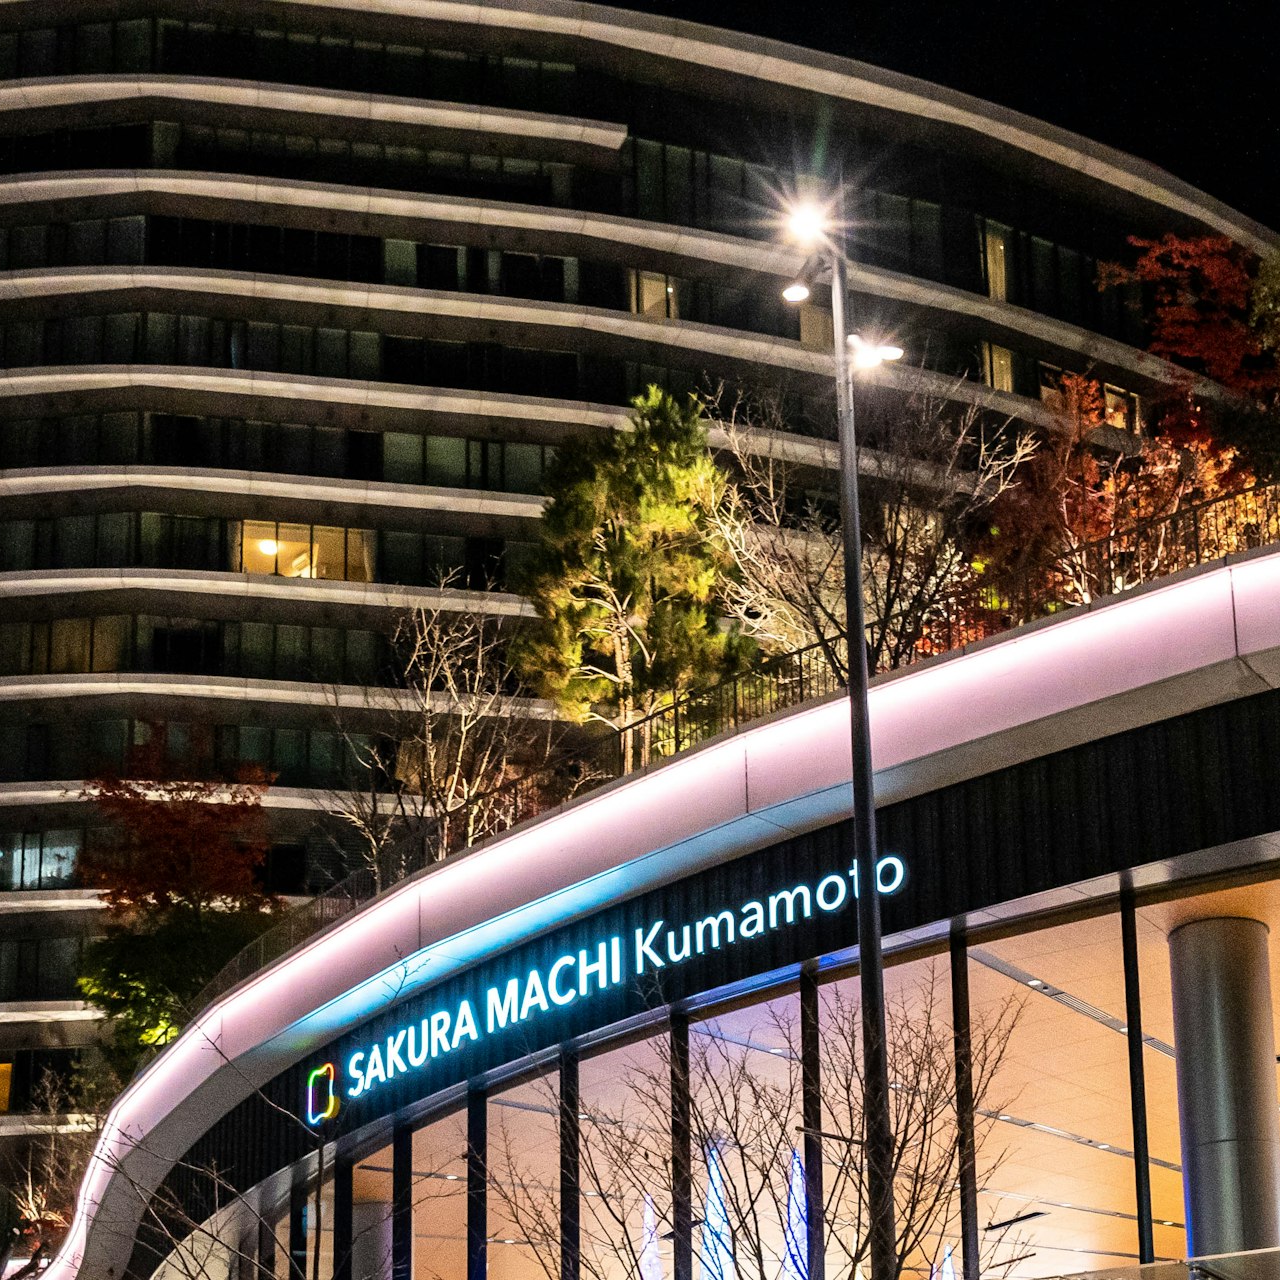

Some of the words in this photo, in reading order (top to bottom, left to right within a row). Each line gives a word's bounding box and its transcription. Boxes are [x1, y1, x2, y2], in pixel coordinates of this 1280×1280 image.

[347, 999, 479, 1098] SAKURA
[486, 936, 621, 1034] MACHI
[634, 855, 905, 976] Kumamoto
